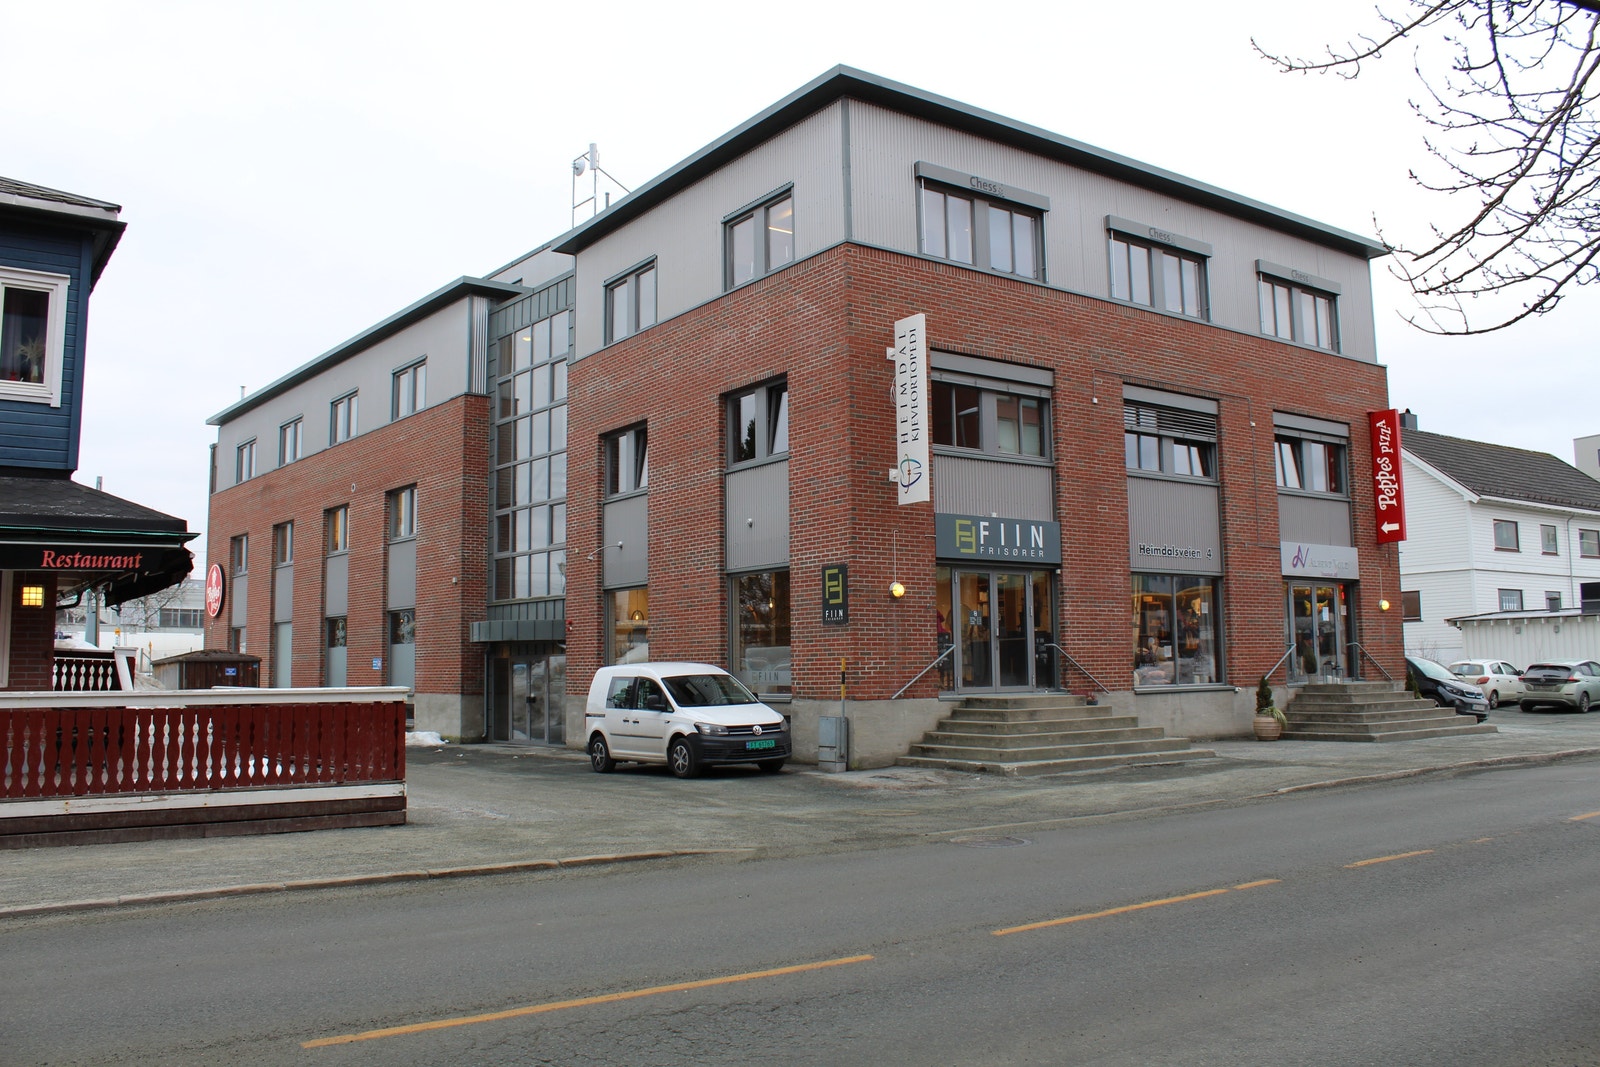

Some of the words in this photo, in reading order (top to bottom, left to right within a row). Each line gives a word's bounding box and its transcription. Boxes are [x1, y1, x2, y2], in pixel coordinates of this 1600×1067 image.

[970, 176, 997, 193] Chess
[1149, 227, 1171, 242] Chess
[898, 331, 909, 444] HEIMDAL
[909, 328, 920, 442] KJEVEORTOPEDI
[1375, 457, 1399, 511] Peppes
[979, 521, 1044, 549] FIIN
[41, 550, 143, 569] Restaurant
[980, 546, 1045, 558] FRISØRER
[1139, 543, 1201, 558] Heimdalsveien
[1206, 548, 1212, 559] 4
[825, 609, 844, 618] FIIN
[758, 671, 779, 681] FIIN
